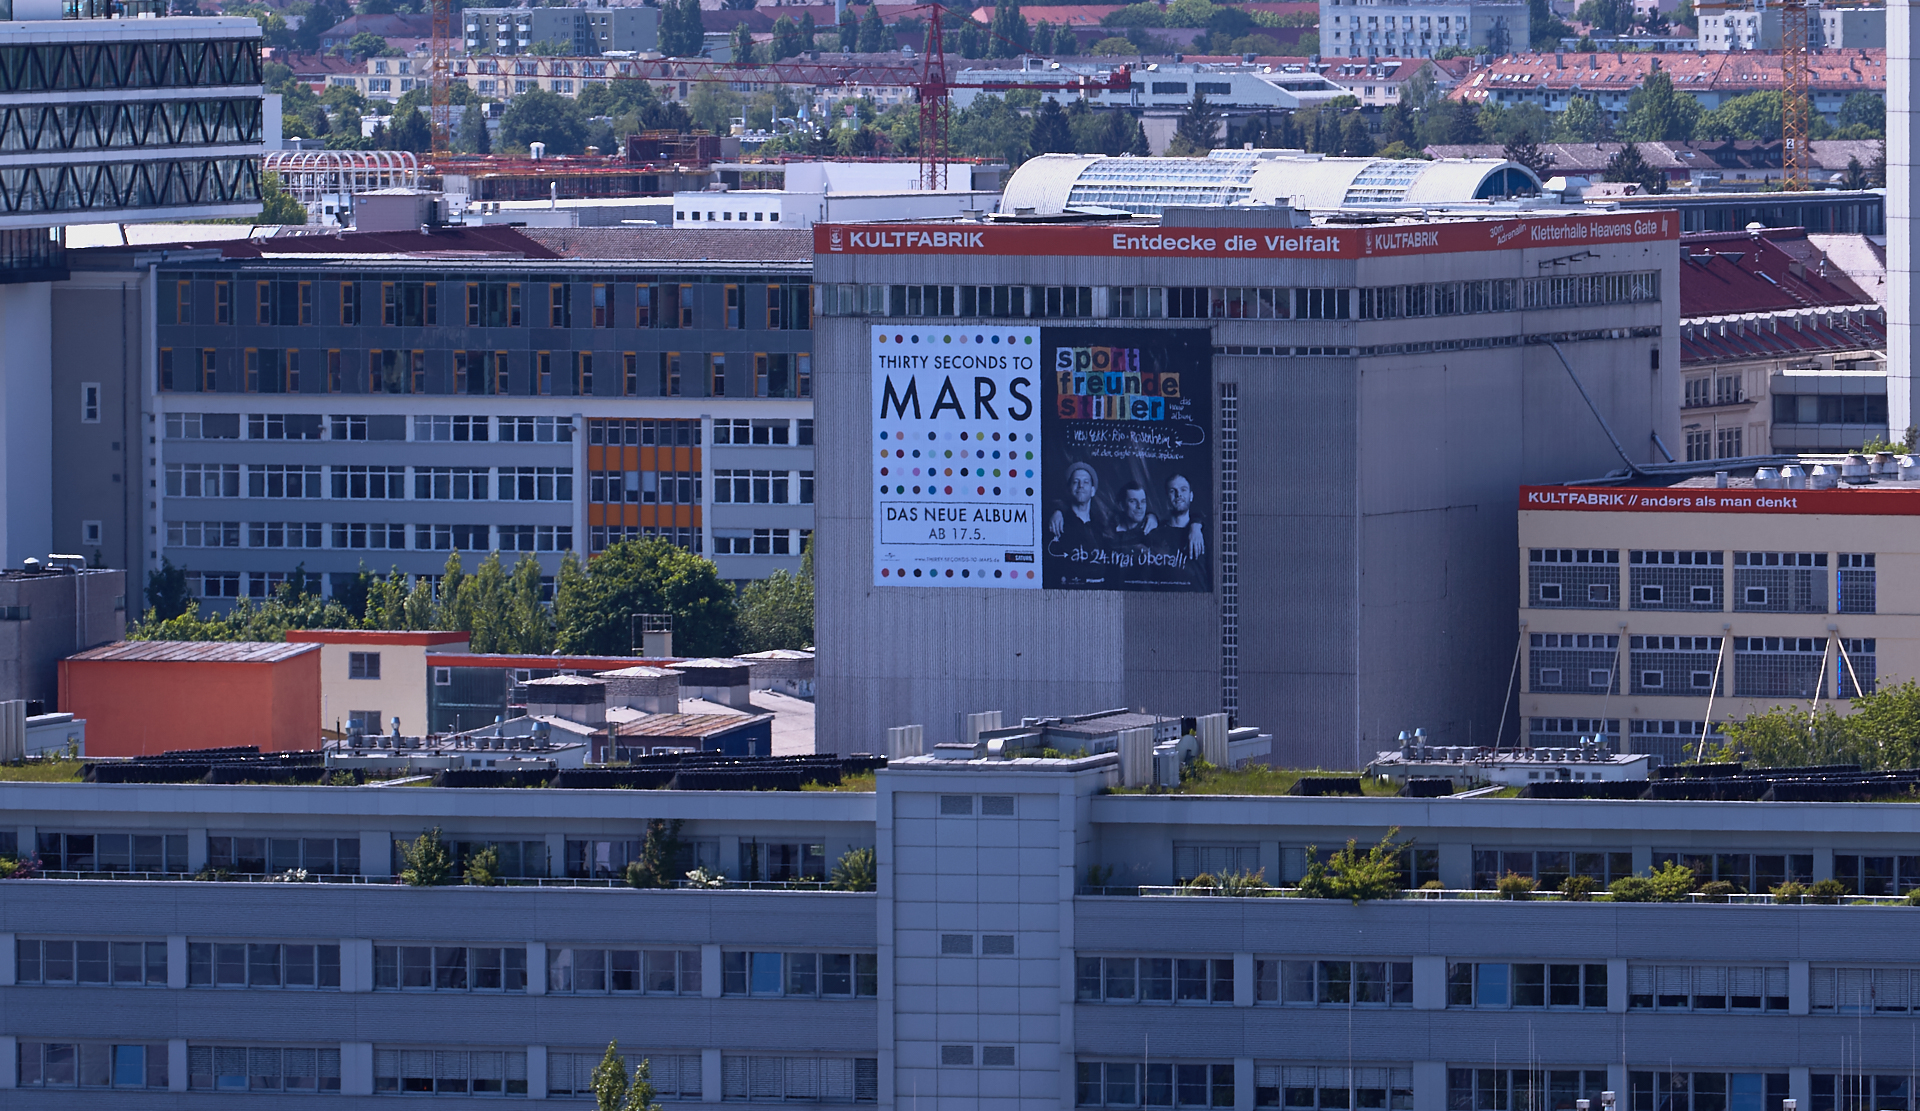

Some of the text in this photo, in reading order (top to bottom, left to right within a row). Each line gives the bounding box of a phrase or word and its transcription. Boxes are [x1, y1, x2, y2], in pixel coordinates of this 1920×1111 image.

[1787, 139, 1793, 148] 2
[849, 231, 985, 248] KULTFABRIK
[1489, 223, 1504, 239] 30m
[1496, 222, 1527, 246] Adrenalin
[1531, 219, 1657, 241] Kletterhalle Heavens Gate
[1112, 233, 1340, 253] Entdecke die Vielfalt
[1375, 231, 1439, 250] KULTFABRIK
[879, 355, 1033, 370] THIRTY SECONDS TO
[1057, 349, 1138, 371] sport
[1059, 372, 1178, 397] freunde
[880, 374, 1033, 421] MARS
[1060, 396, 1162, 418] stiller
[1528, 491, 1624, 506] KULTFABRIK
[1695, 495, 1717, 508] als
[1720, 497, 1752, 508] man
[1756, 495, 1798, 509] denkt
[887, 507, 1027, 523] DAS NEUE ALBUM
[928, 527, 986, 541] AB 17.5.
[1070, 544, 1089, 563] ab
